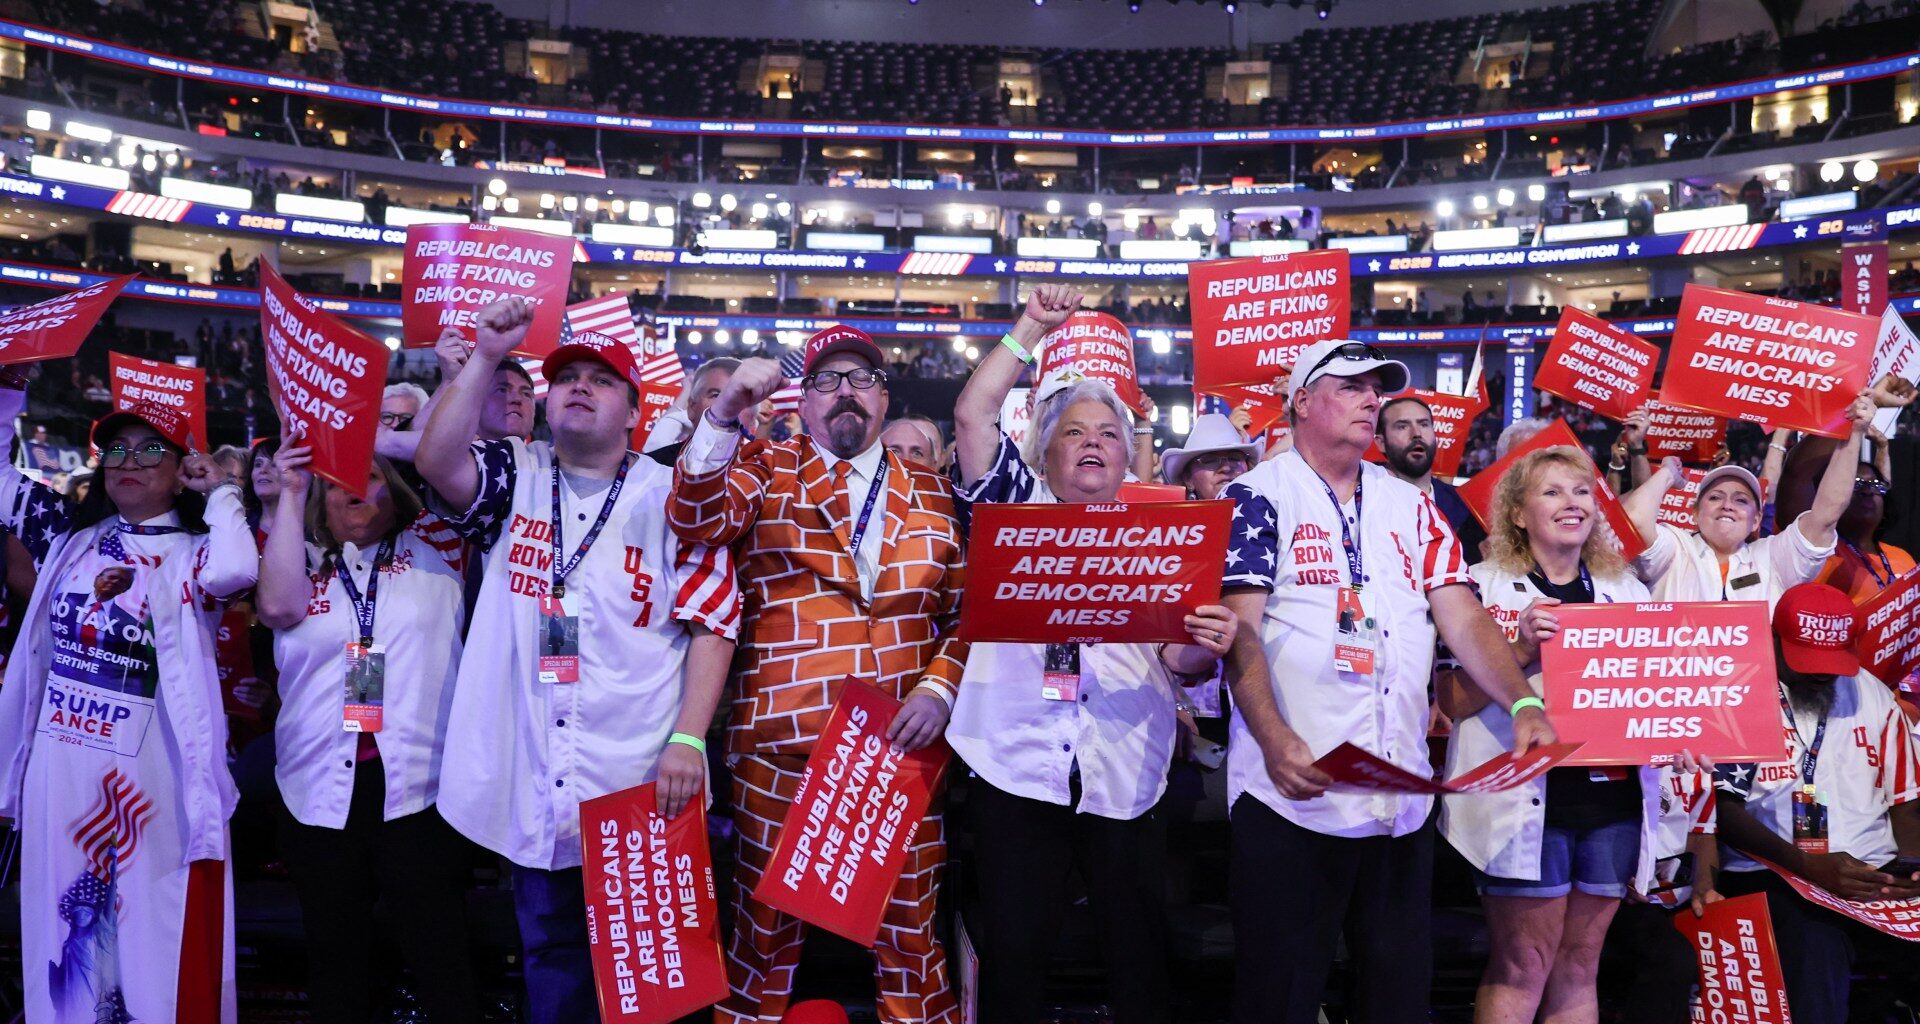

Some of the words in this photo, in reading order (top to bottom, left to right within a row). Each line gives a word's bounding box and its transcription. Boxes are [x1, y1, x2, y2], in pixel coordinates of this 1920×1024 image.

[1775, 76, 1806, 88] DALLAS
[1653, 96, 1681, 107] DALLAS
[1426, 121, 1452, 131] DALLAS
[1538, 111, 1565, 121] DALLAS
[1214, 132, 1238, 140] DALLAS
[292, 220, 380, 240] REPUBLICAN
[469, 223, 498, 232] DALLAS
[415, 240, 556, 268] REPUBLICANS
[680, 252, 761, 265] REPUBLICAN
[763, 254, 847, 267] CONVENTION
[1262, 254, 1288, 263] DALLAS
[1438, 252, 1524, 268] REPUBLICAN
[1528, 244, 1619, 262] CONVENTION
[422, 264, 458, 280] ARE
[462, 264, 536, 288] FIXING
[1060, 262, 1141, 275] REPUBLICAN
[1143, 263, 1188, 275] CONVE
[1207, 268, 1336, 298] REPUBLICANS
[1854, 253, 1873, 315] WASHI
[293, 292, 316, 314] DALLAS
[414, 286, 544, 306] DEMOCRAS'
[1766, 298, 1798, 309] DALLAS
[438, 310, 481, 329] MES
[1222, 304, 1264, 322] ARE
[1270, 294, 1328, 316] FIXING
[264, 286, 368, 378] REPUBLICANS
[1215, 316, 1336, 346] DEMOCRATS'
[1696, 305, 1858, 348] REPUBLICANS
[812, 332, 863, 352] VOT
[1047, 345, 1076, 365] ARE
[1080, 342, 1128, 360] FIXING
[1568, 322, 1650, 366] REPUBLICANS
[1704, 332, 1754, 353] ARE
[1756, 340, 1836, 368] FIXING
[1879, 326, 1900, 358] THE
[268, 324, 286, 358] ARE
[286, 348, 348, 399] FIXING
[1570, 342, 1596, 360] ARE
[1598, 352, 1638, 378] FIXING
[116, 366, 194, 392] REPUBLICANS
[1558, 353, 1640, 394] DEMOCRATS'
[1690, 352, 1842, 392] DEMOCRATS'
[121, 384, 141, 400] ARE
[142, 390, 185, 407] FIXING
[267, 345, 354, 430] DEMOCRATS'
[1574, 379, 1612, 400] MESS
[1726, 383, 1792, 408] MESS
[142, 406, 179, 424] ABOUT
[1648, 413, 1674, 424] ARE
[1675, 416, 1715, 426] FIXING
[1739, 412, 1768, 424] 2026
[1647, 426, 1716, 438] EMOCRATS'
[1658, 440, 1693, 450] MESS
[876, 460, 886, 481] DALLAS
[609, 480, 622, 500] DALLAS
[1086, 504, 1128, 512] DALLAS
[851, 534, 861, 555] ALLAS
[994, 524, 1206, 548] REPUBLICANS
[509, 543, 554, 572] ROW
[554, 548, 562, 574] DALLAS
[560, 555, 580, 578] DALLAS
[1010, 556, 1074, 575] ARE
[1080, 556, 1182, 576] FIXING
[1294, 546, 1332, 564] ROW
[509, 570, 549, 598] OES
[1296, 569, 1340, 586] JOES
[544, 596, 551, 609] 1
[994, 582, 1191, 602] DEMOCRATS'
[1343, 591, 1349, 602] 1
[365, 601, 374, 626] DALLAS
[1046, 609, 1132, 626] MESS
[1636, 604, 1673, 612] DALLAS
[50, 600, 70, 618] NO
[75, 606, 120, 636] TAX
[122, 624, 155, 648] ON
[1797, 613, 1853, 630] TRUMP
[1879, 612, 1909, 644] ARE
[1562, 626, 1748, 649] REPUBLICANS
[54, 637, 85, 654] OCIAL
[87, 647, 150, 670] SECURITY
[352, 645, 358, 658] 1
[54, 653, 99, 674] ERTIME
[1581, 658, 1638, 679] ARE
[1642, 656, 1735, 678] FIXING
[48, 687, 130, 723] RUMP
[1572, 686, 1750, 710] DEMOCRATS'
[50, 710, 113, 737] ANCE
[1626, 716, 1702, 739] MESS
[58, 735, 82, 746] 2024
[1650, 754, 1675, 764] 202
[1758, 765, 1798, 782] JOES
[794, 766, 814, 805] DALLAS
[782, 705, 869, 892] REPUBLICANS
[814, 824, 846, 884] ARE
[835, 734, 882, 826] FIXING
[830, 744, 905, 906] DEMOCRATS
[870, 790, 909, 867] MESS
[902, 822, 918, 854] 2026
[626, 830, 650, 922] FIXING
[704, 867, 714, 899] 2026
[648, 812, 684, 988] DEMOCRATS'
[675, 854, 700, 928] MESS
[587, 905, 598, 944] DALLAS
[600, 819, 640, 1014] REPUBLICANS
[636, 930, 660, 986] ARE
[1719, 938, 1744, 992] ARE
[1698, 931, 1728, 1024] DEMOC
